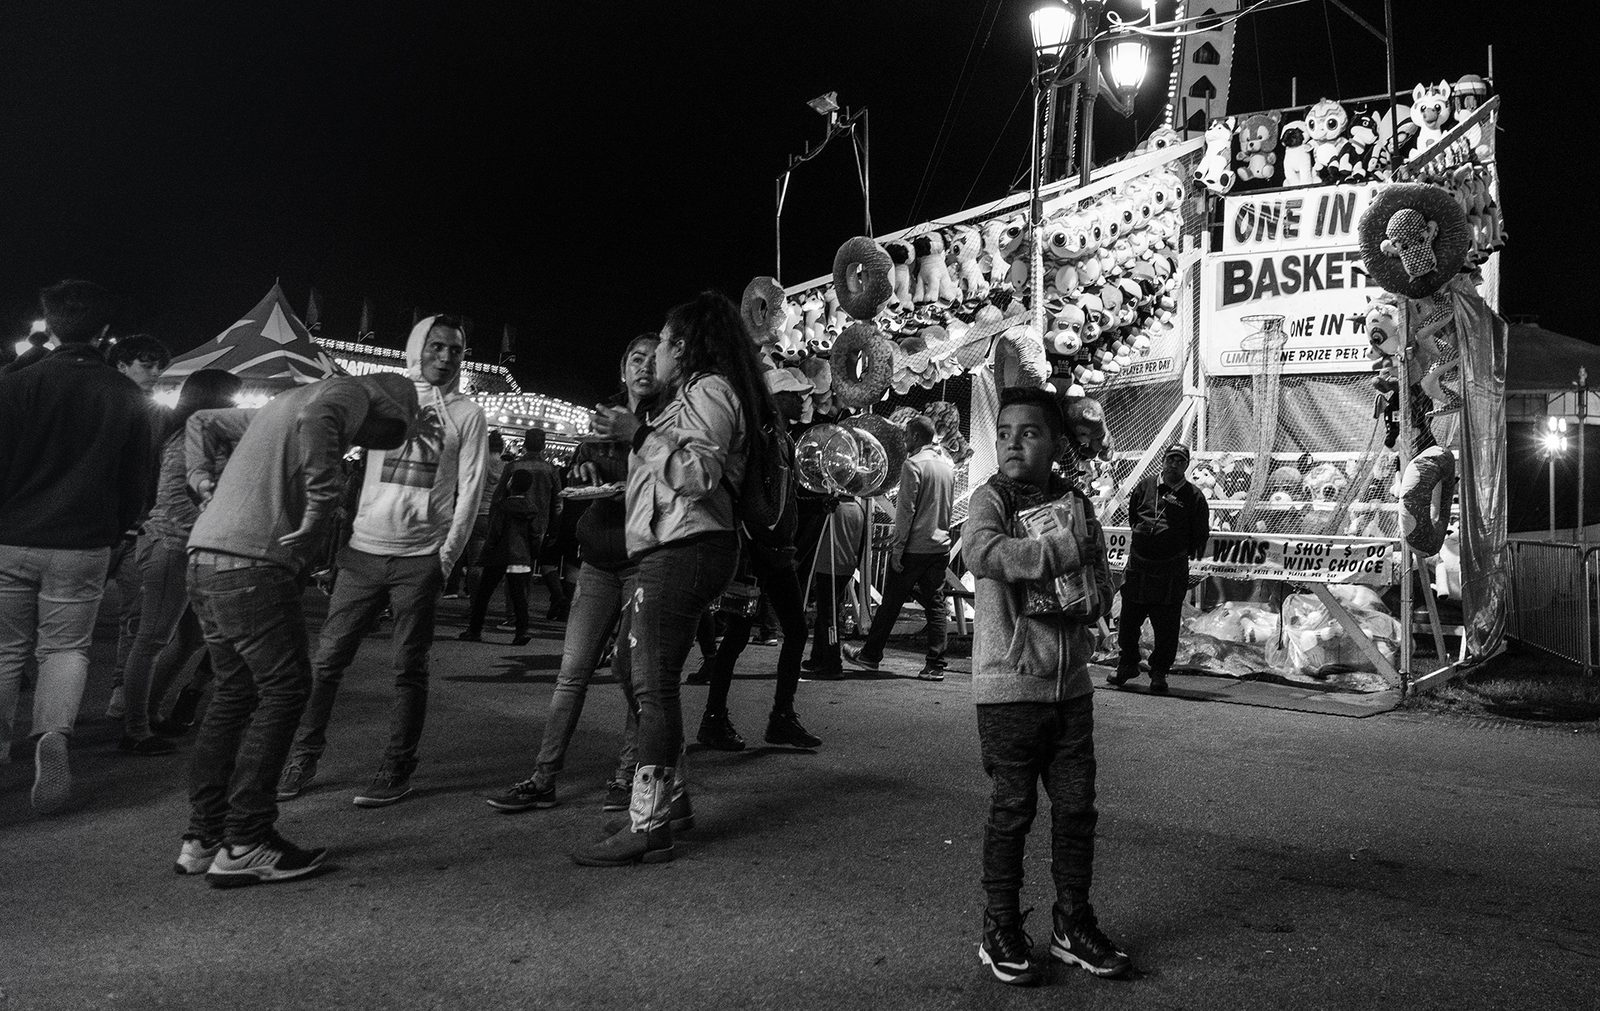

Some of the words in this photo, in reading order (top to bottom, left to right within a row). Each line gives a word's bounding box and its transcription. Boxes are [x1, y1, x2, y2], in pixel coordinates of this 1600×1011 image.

[1234, 199, 1303, 243] ONE
[1315, 193, 1356, 236] IN
[1223, 251, 1377, 306] BASKET
[1290, 316, 1316, 337] ONE
[1320, 313, 1345, 336] IN
[1299, 349, 1332, 361] PRIZE
[1335, 348, 1359, 360] PER
[1145, 361, 1157, 372] PER
[1159, 359, 1171, 371] DAY
[1213, 539, 1270, 565] WINS
[1282, 542, 1289, 554] 1
[1294, 543, 1334, 557] SHOT
[1283, 556, 1324, 571] WINS
[1328, 558, 1385, 574] CHOICE
